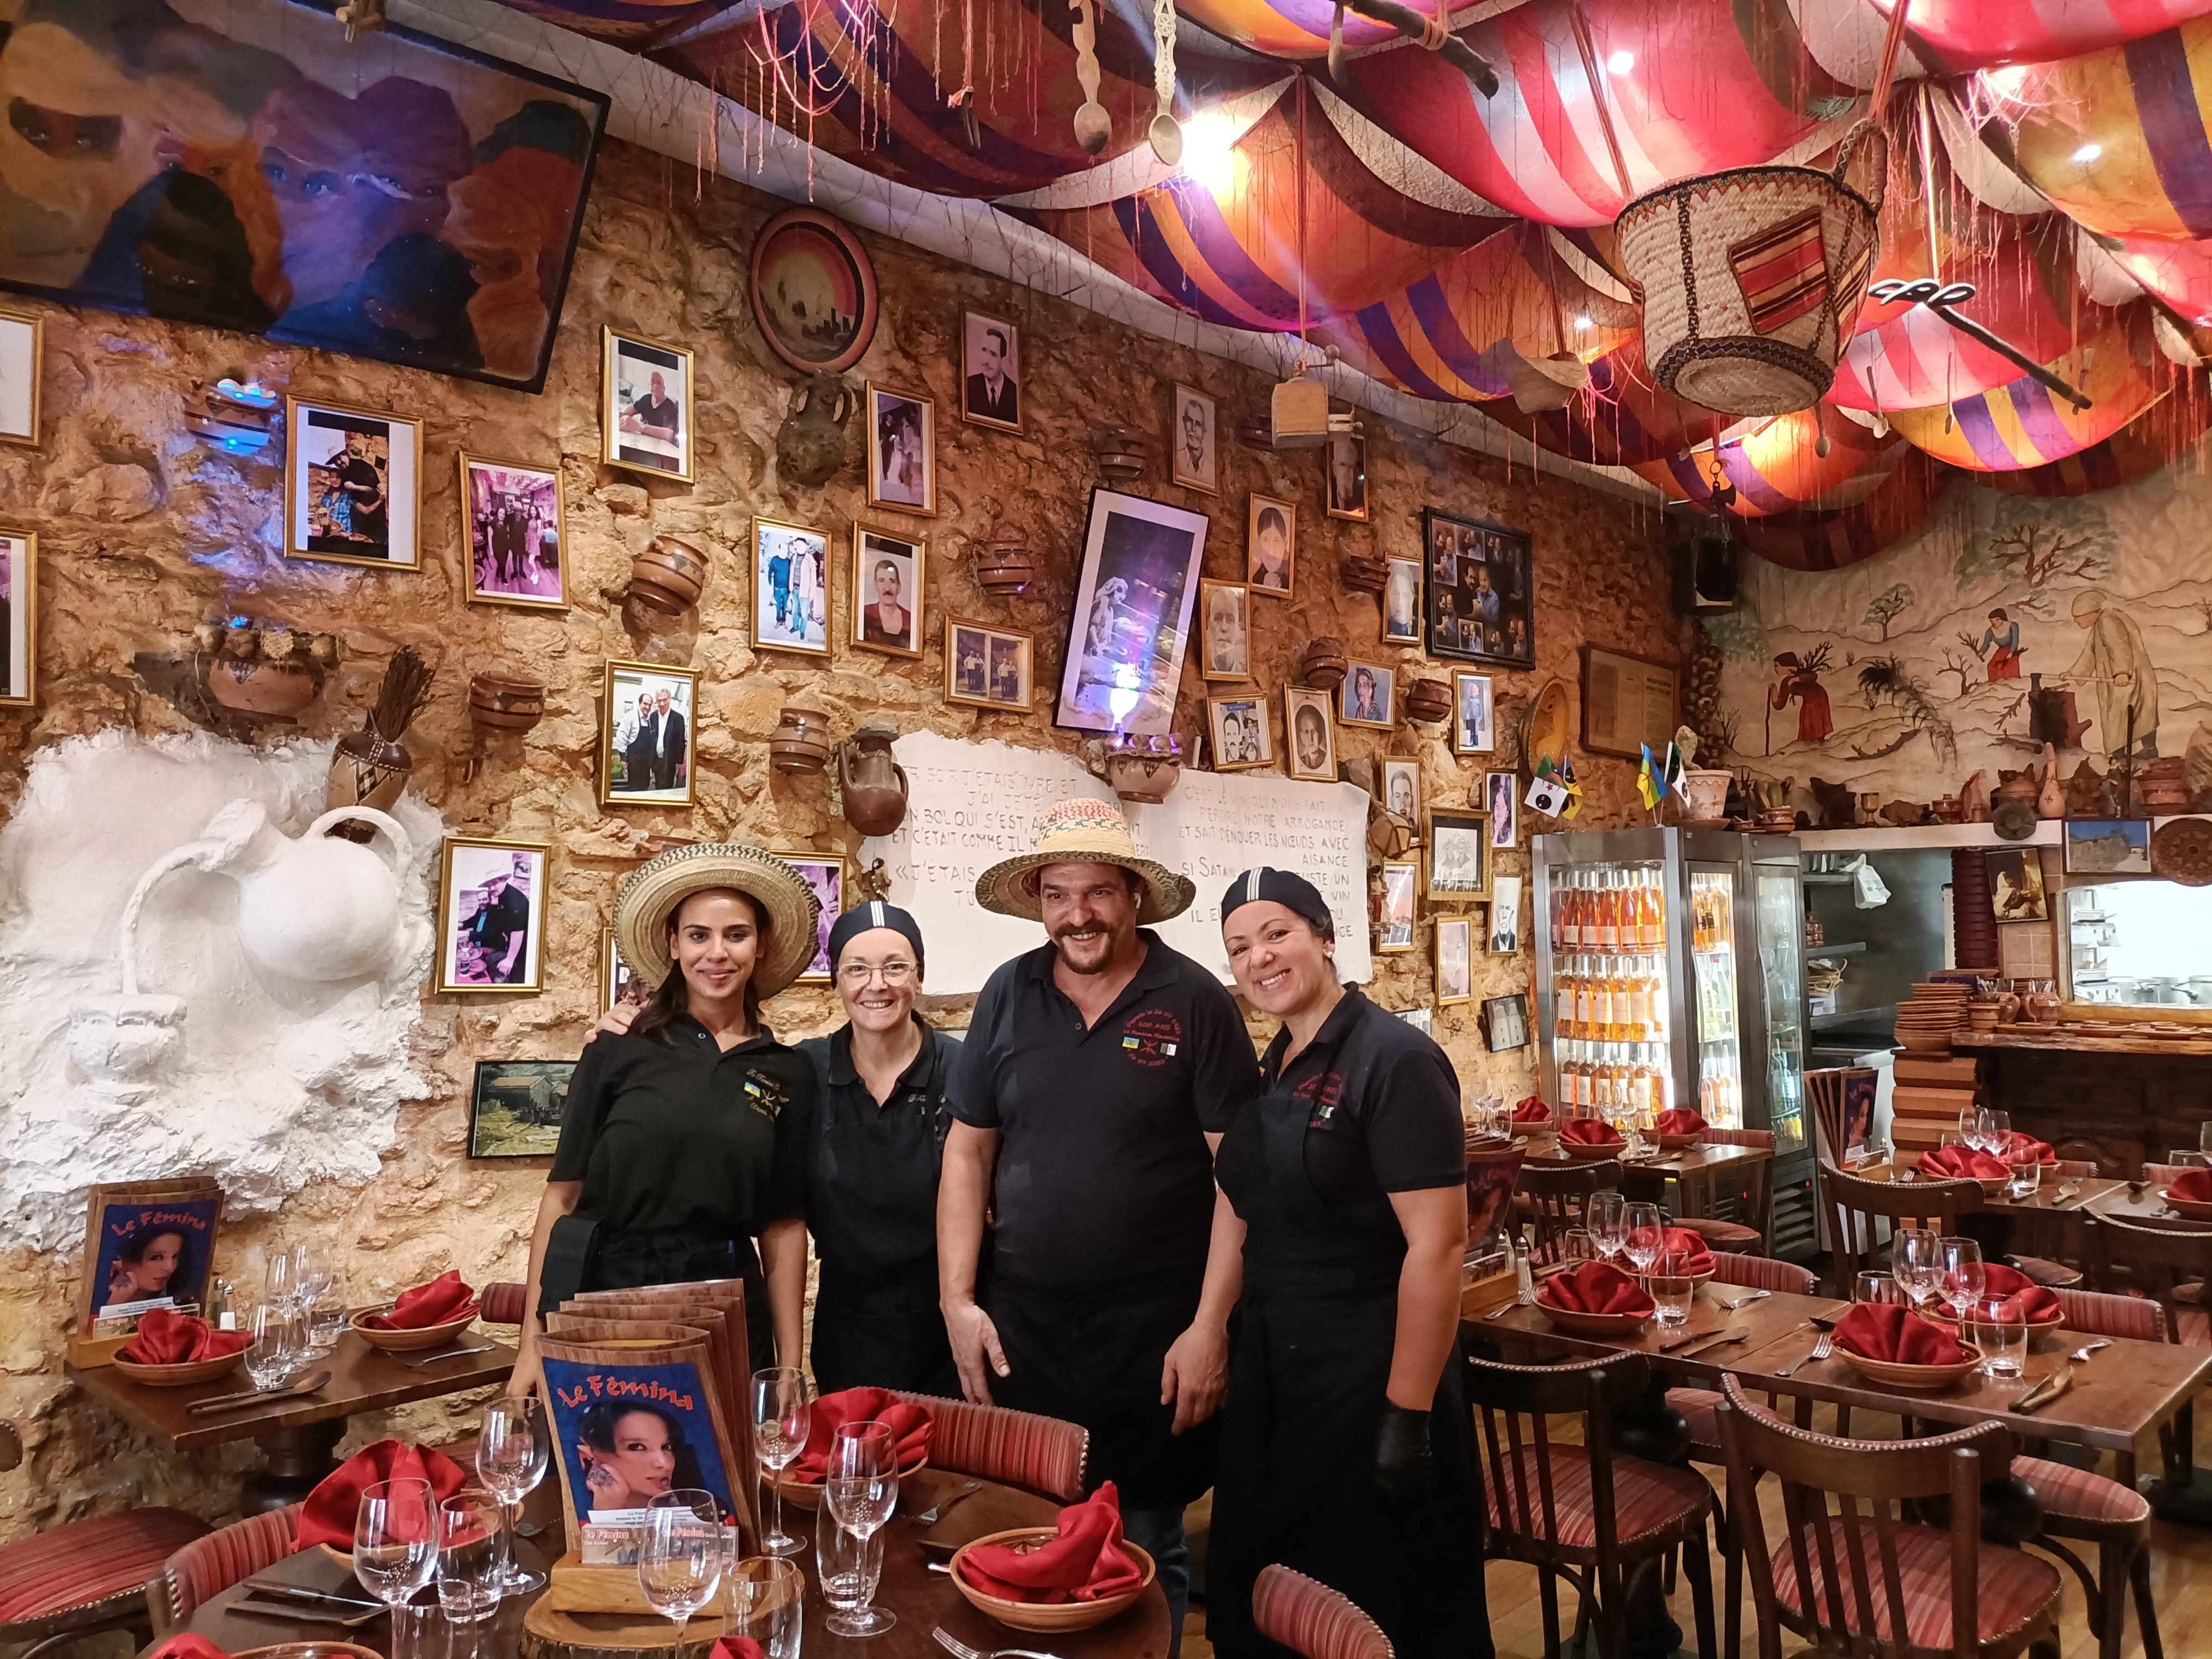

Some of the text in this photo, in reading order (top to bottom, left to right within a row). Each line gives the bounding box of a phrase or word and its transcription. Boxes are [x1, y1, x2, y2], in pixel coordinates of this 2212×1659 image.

[1061, 779, 1078, 795] ET
[967, 790, 994, 807] J'AI
[1183, 785, 1213, 801] C'EST
[1229, 793, 1248, 807] VIN
[1251, 795, 1269, 809] QUI
[1271, 797, 1300, 811] NOUS
[1305, 800, 1326, 812] FAIT
[924, 808, 951, 826] BOL
[954, 812, 978, 828] QUI
[1199, 807, 1345, 833] PERDRE NOTRE ARROGANCE
[891, 827, 907, 844] ET
[961, 832, 1004, 852] COMME
[1006, 836, 1026, 853] IL
[1178, 826, 1192, 839] ET
[1194, 826, 1216, 839] SAIT
[1264, 832, 1279, 848] LES
[1321, 837, 1350, 851] AVEC
[1302, 853, 1349, 868] AISANCE
[1181, 861, 1194, 877] SI
[1334, 873, 1350, 886] UN
[1331, 890, 1350, 902] VIN
[1190, 909, 1204, 924] IL
[111, 1219, 136, 1237] Le
[557, 1374, 693, 1410] Le Fémina
[584, 1529, 596, 1539] Le
